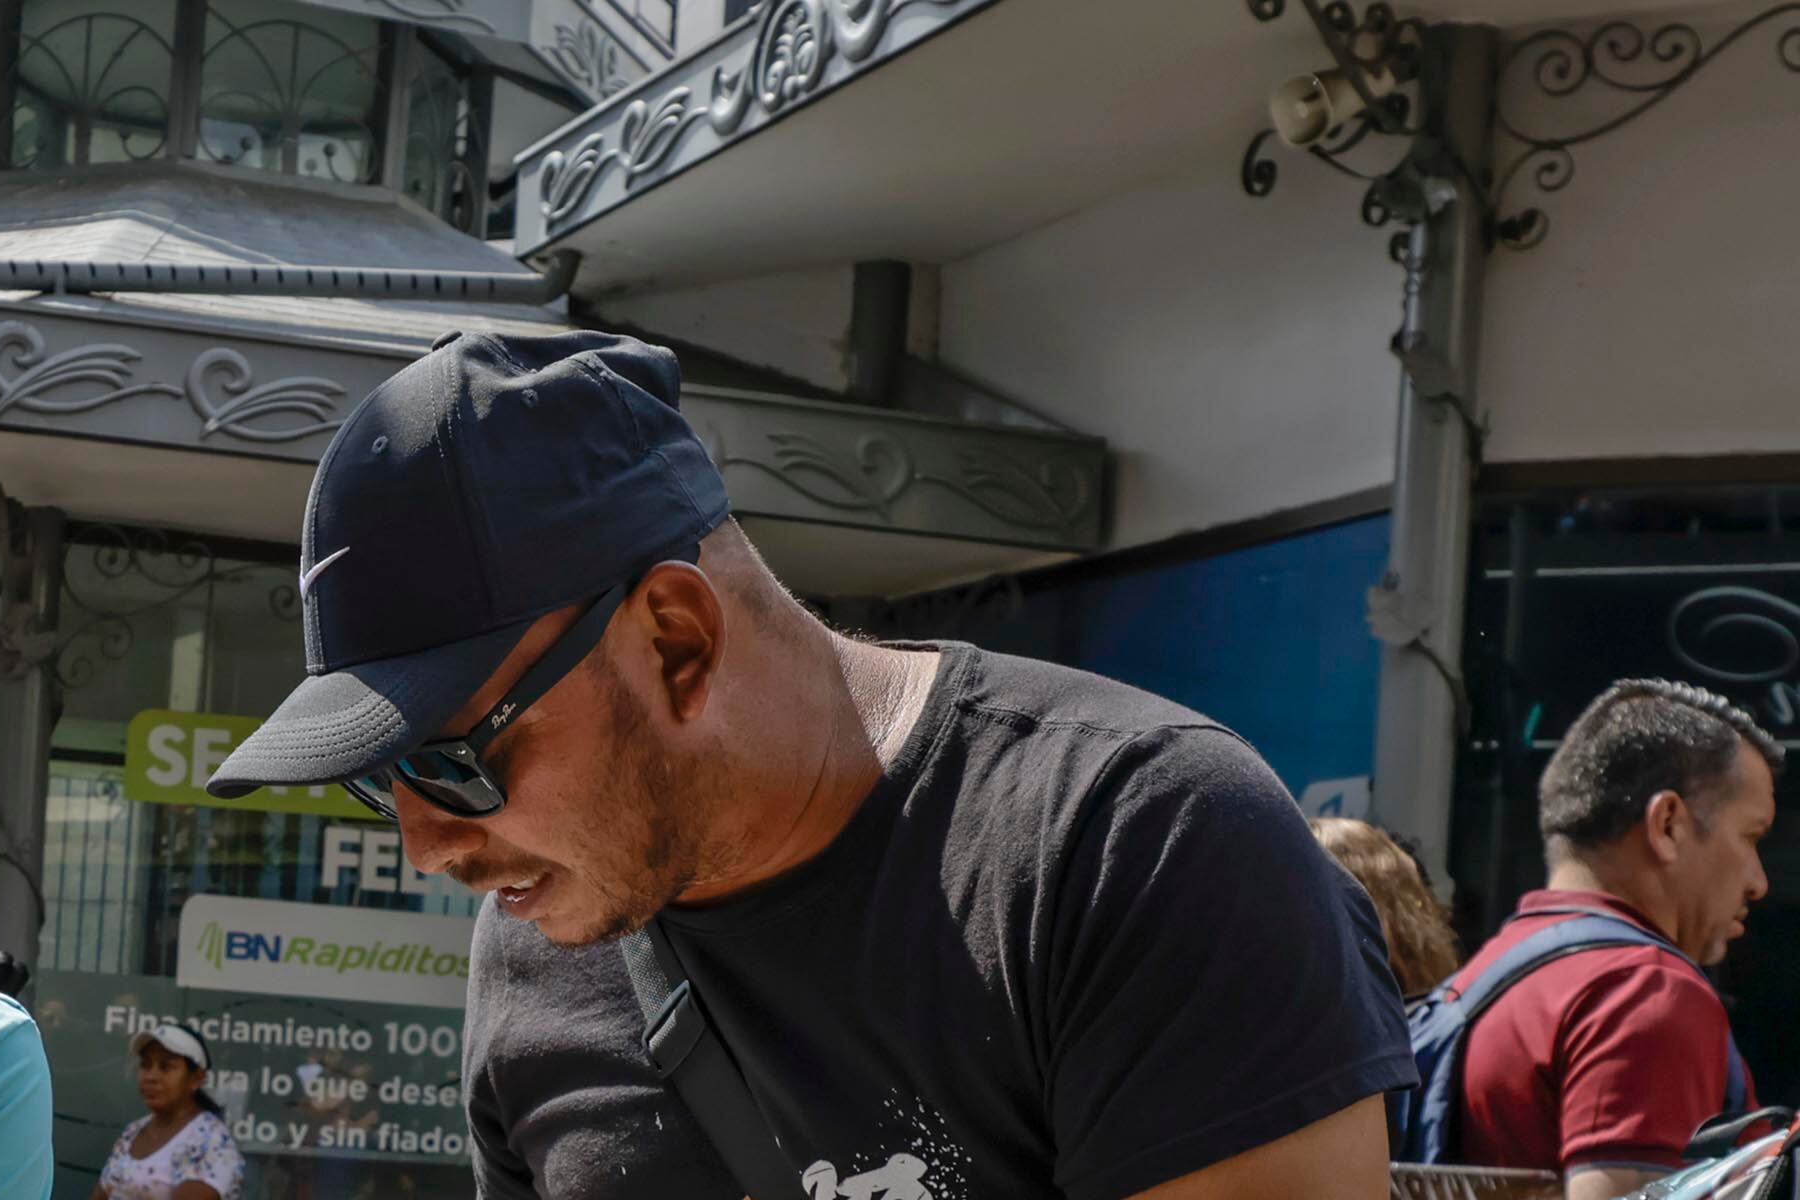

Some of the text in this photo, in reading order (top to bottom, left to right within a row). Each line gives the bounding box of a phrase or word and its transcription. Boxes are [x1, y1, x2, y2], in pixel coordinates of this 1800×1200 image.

[104, 1006, 372, 1052] Finciamiento
[202, 1066, 465, 1108] ara lo que dese
[319, 1116, 366, 1148] sin
